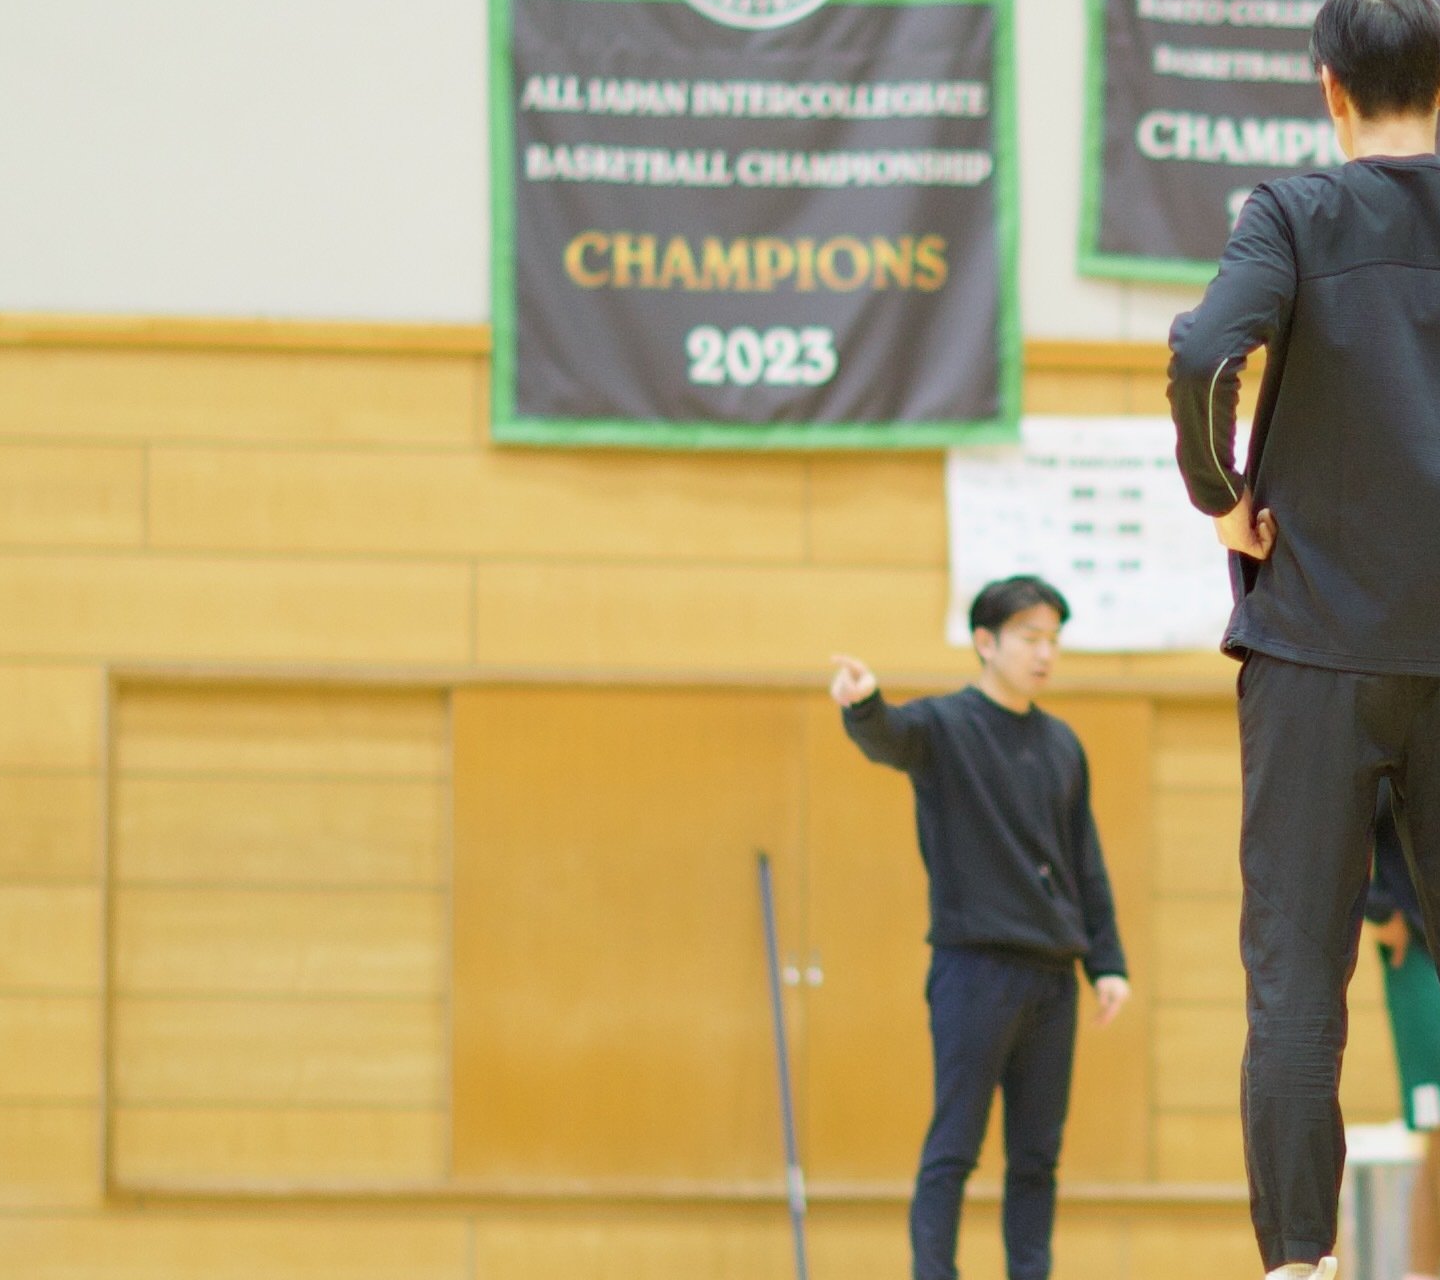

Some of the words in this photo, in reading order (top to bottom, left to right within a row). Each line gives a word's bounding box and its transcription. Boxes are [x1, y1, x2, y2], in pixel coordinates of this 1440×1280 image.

[521, 74, 586, 113] ALL
[587, 77, 689, 116] JAPAN
[525, 143, 734, 188] BASKETBALL
[1136, 108, 1349, 168] CHAMPI
[564, 230, 949, 292] CHAMPIONS
[686, 324, 838, 386] 2023
